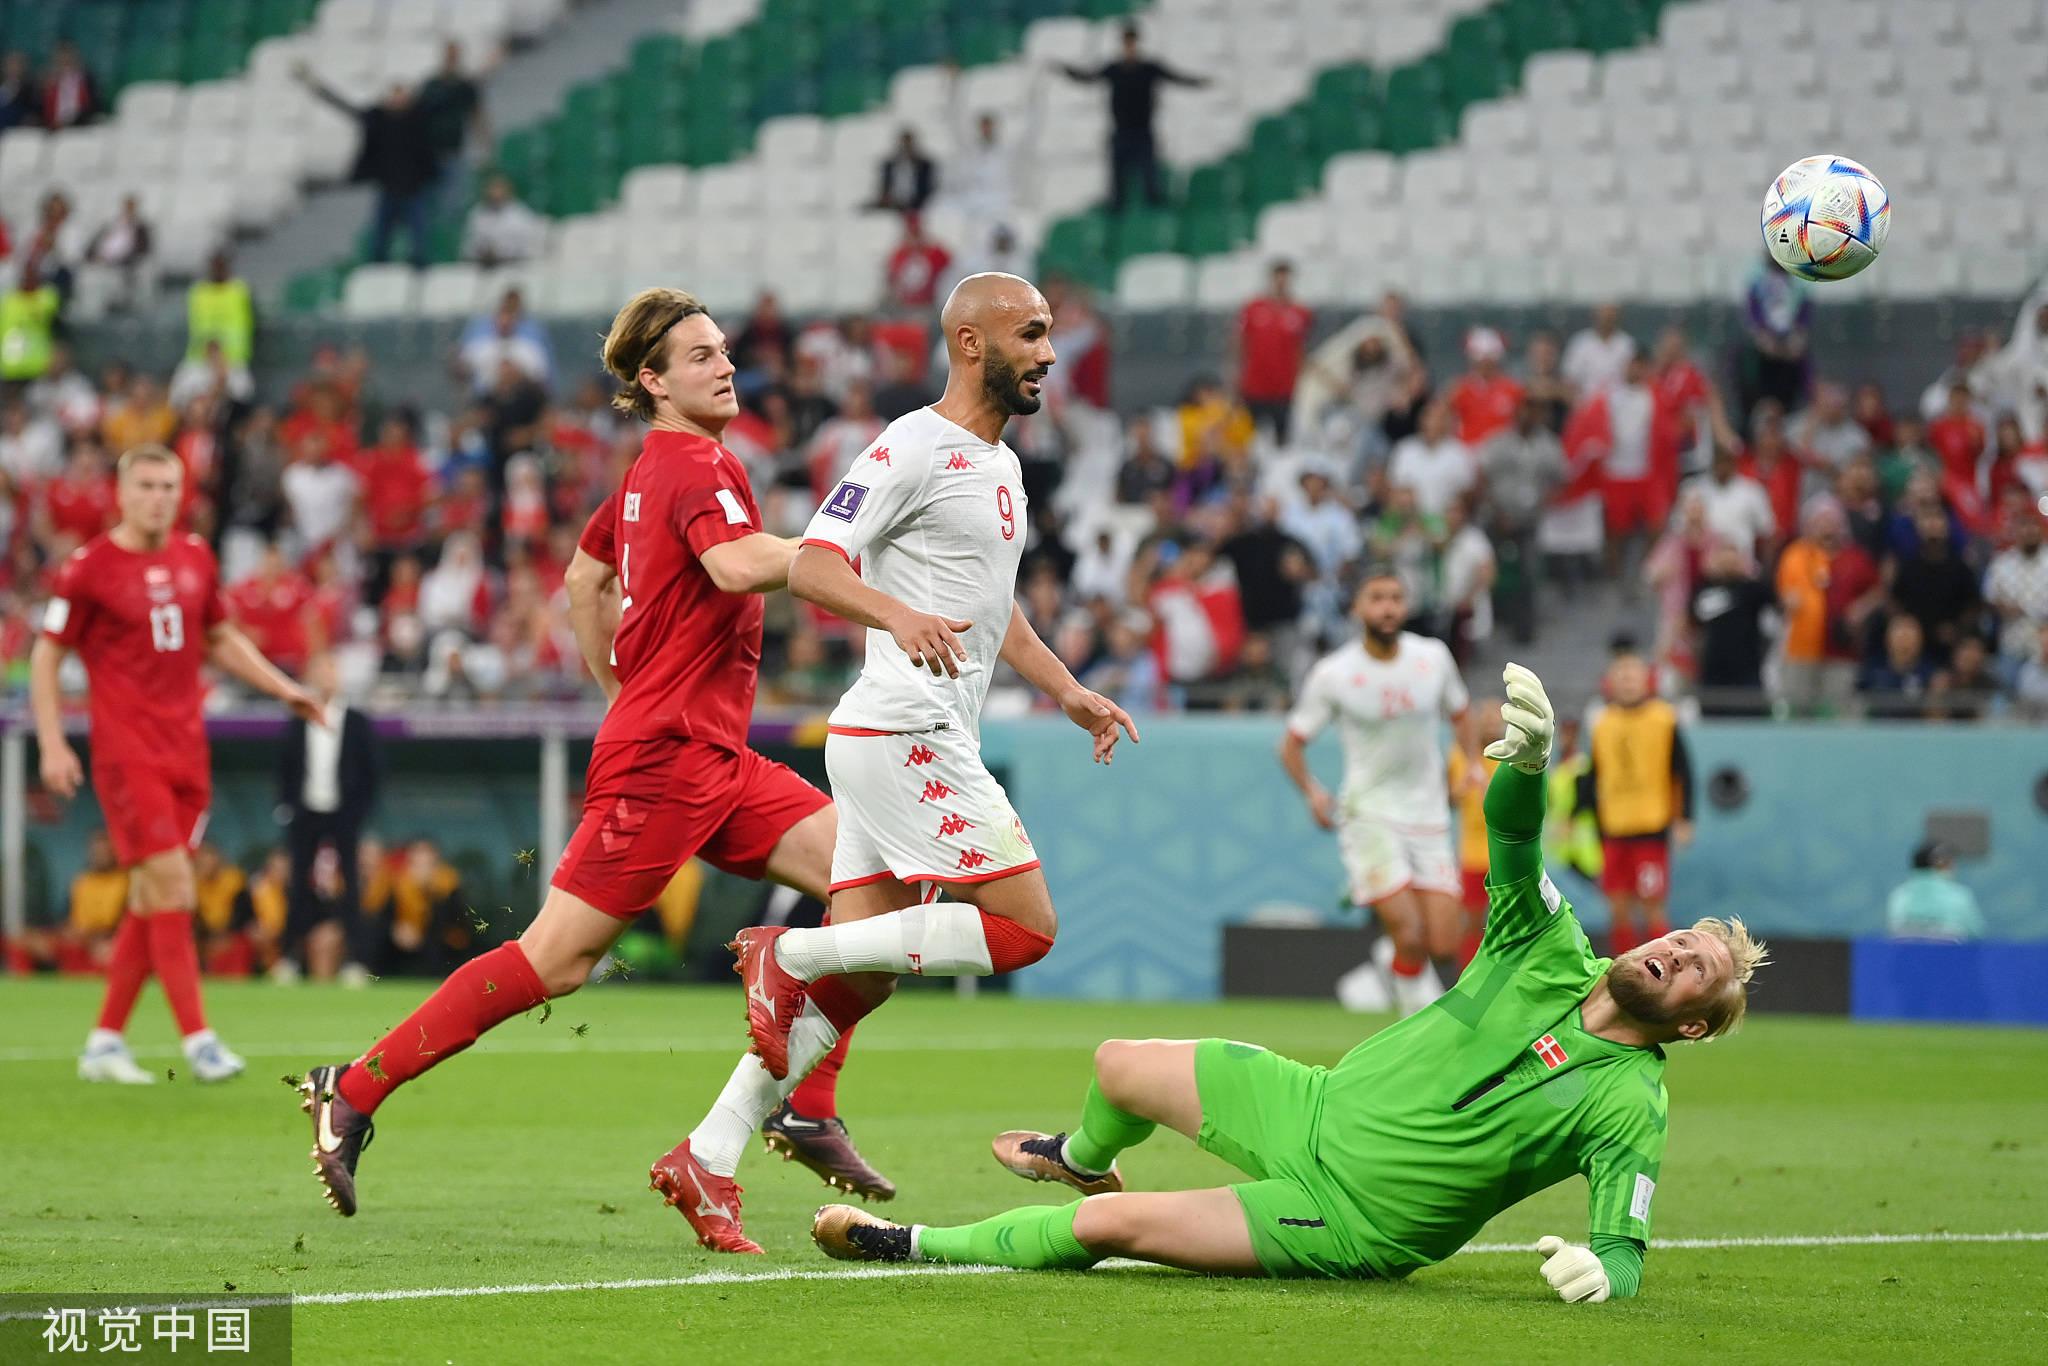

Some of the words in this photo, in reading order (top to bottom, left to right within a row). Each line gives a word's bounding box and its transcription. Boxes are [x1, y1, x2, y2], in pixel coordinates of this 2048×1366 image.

[997, 485, 1015, 540] 9
[150, 603, 184, 653] 13
[1451, 1073, 1506, 1112] 1
[1278, 1216, 1326, 1228] 1
